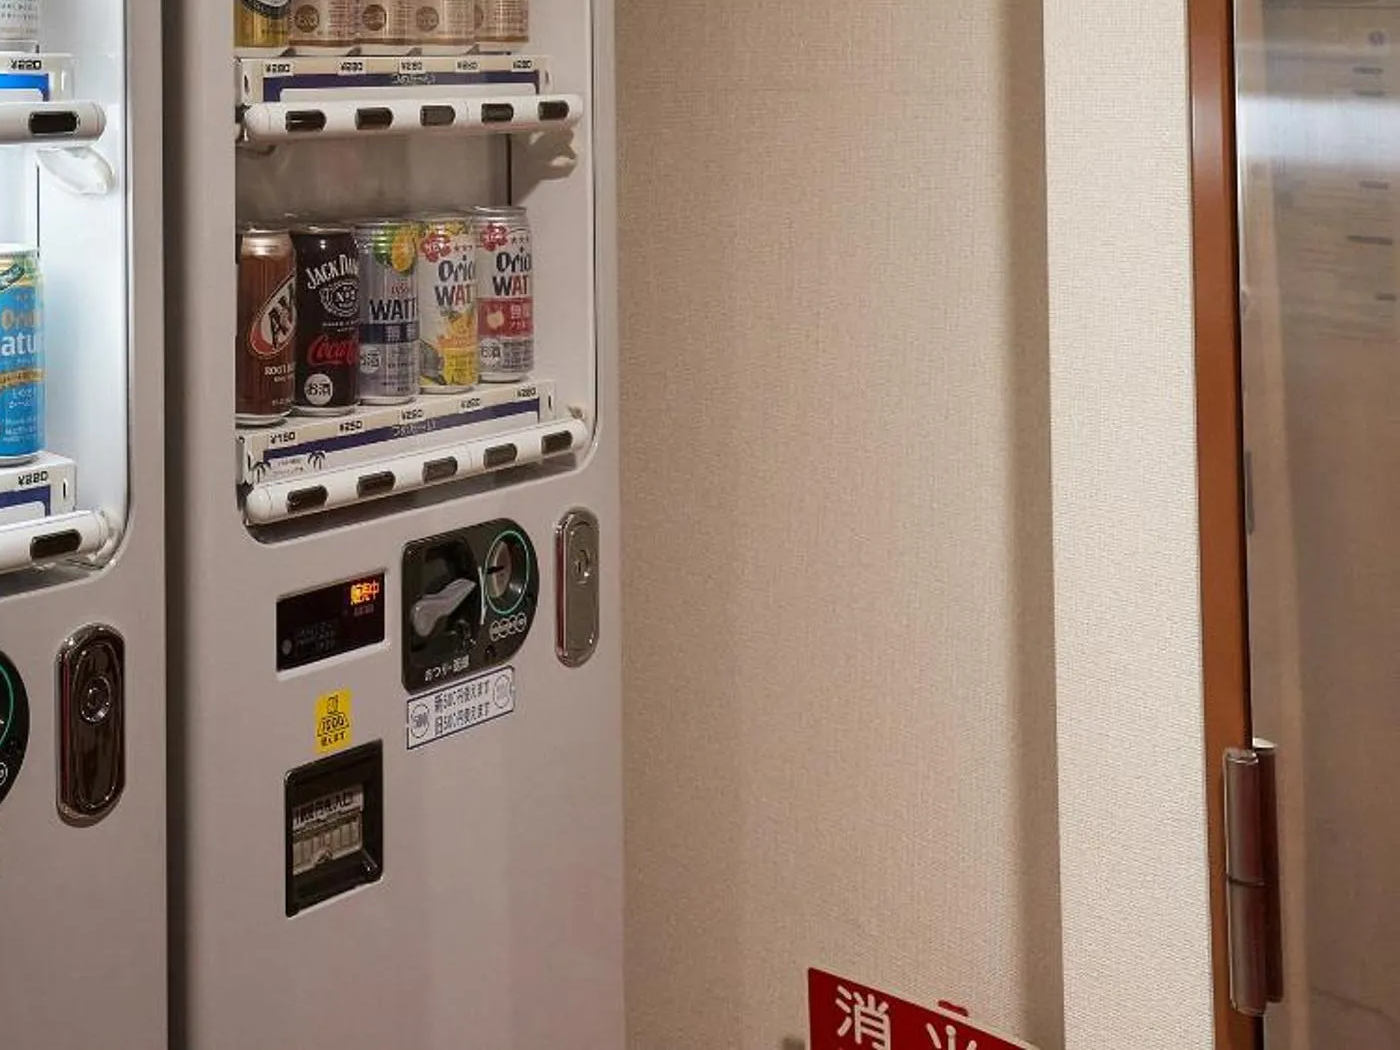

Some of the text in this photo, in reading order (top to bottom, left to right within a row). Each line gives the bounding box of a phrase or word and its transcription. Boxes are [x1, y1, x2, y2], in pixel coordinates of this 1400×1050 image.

[434, 284, 472, 307] WAT
[492, 275, 530, 297] WAT
[368, 298, 416, 322] WATT
